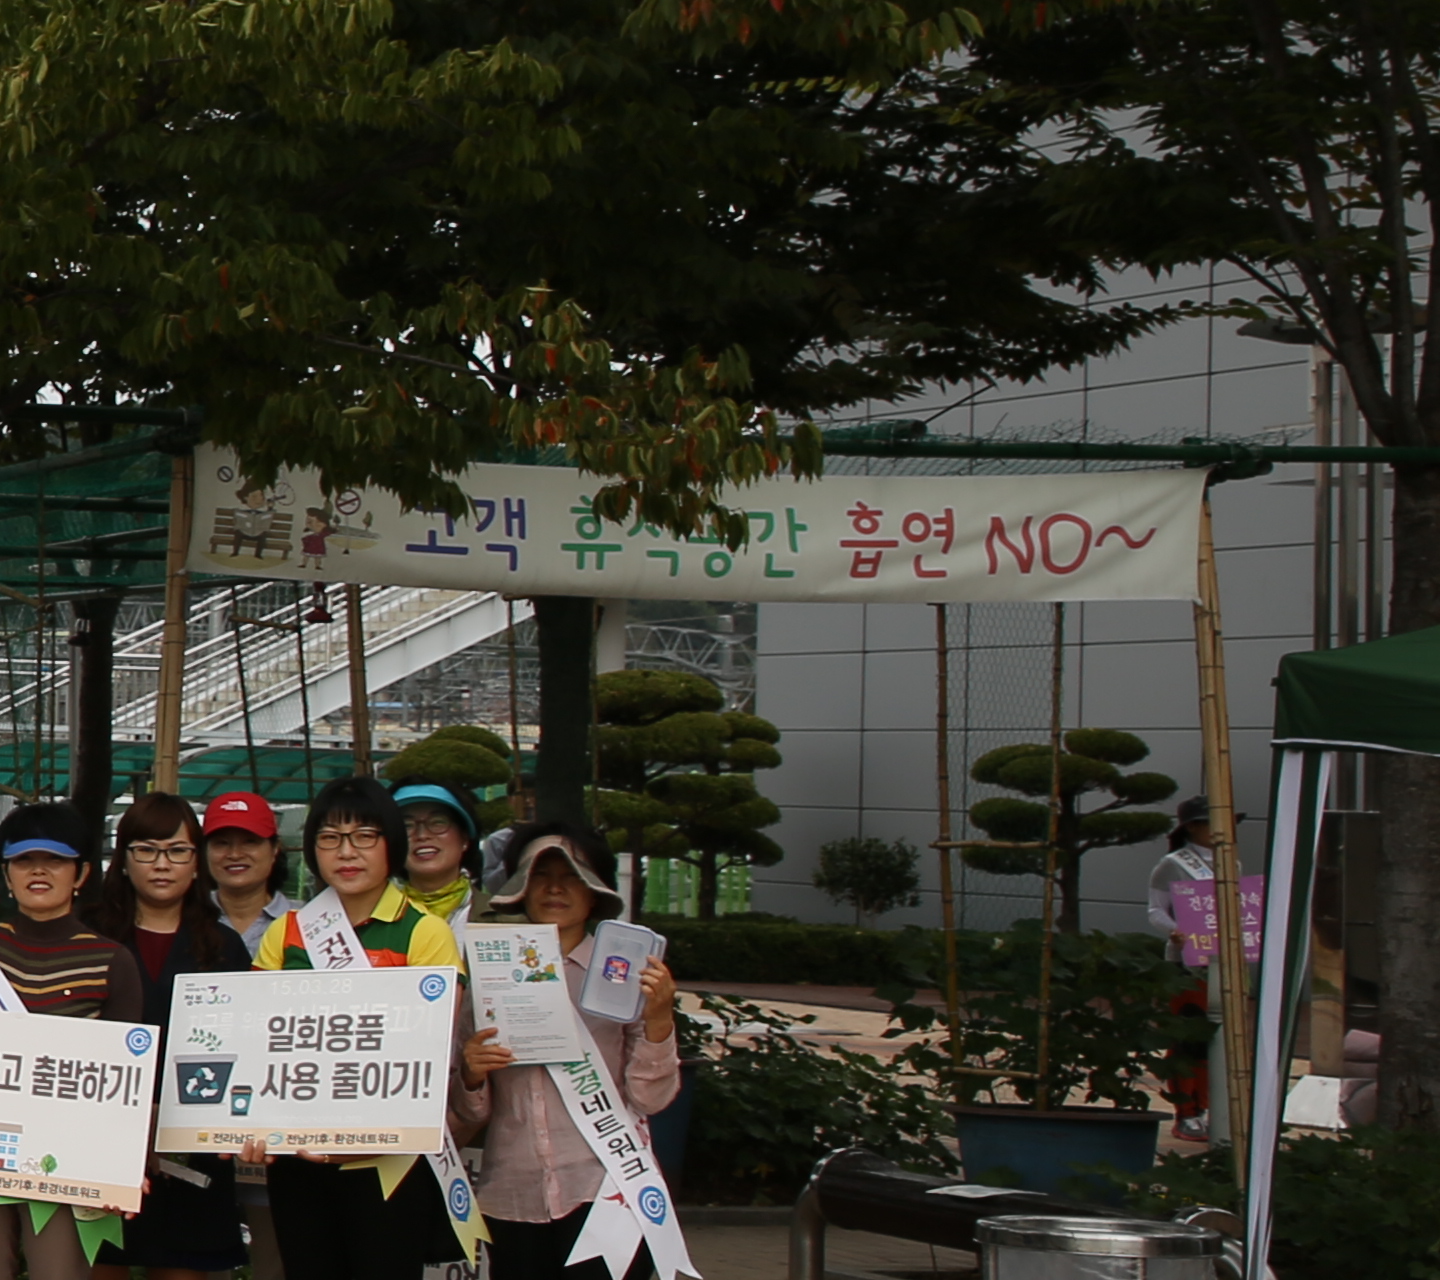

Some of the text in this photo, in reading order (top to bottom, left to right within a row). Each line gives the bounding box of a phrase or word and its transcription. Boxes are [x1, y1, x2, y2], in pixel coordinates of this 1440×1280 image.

[838, 500, 955, 580] 흡연
[267, 1013, 385, 1053] 일회용품
[31, 1055, 143, 1108] 출발하기!
[259, 1060, 433, 1101] 사용 줄이기!
[212, 1132, 255, 1145] 전라남도
